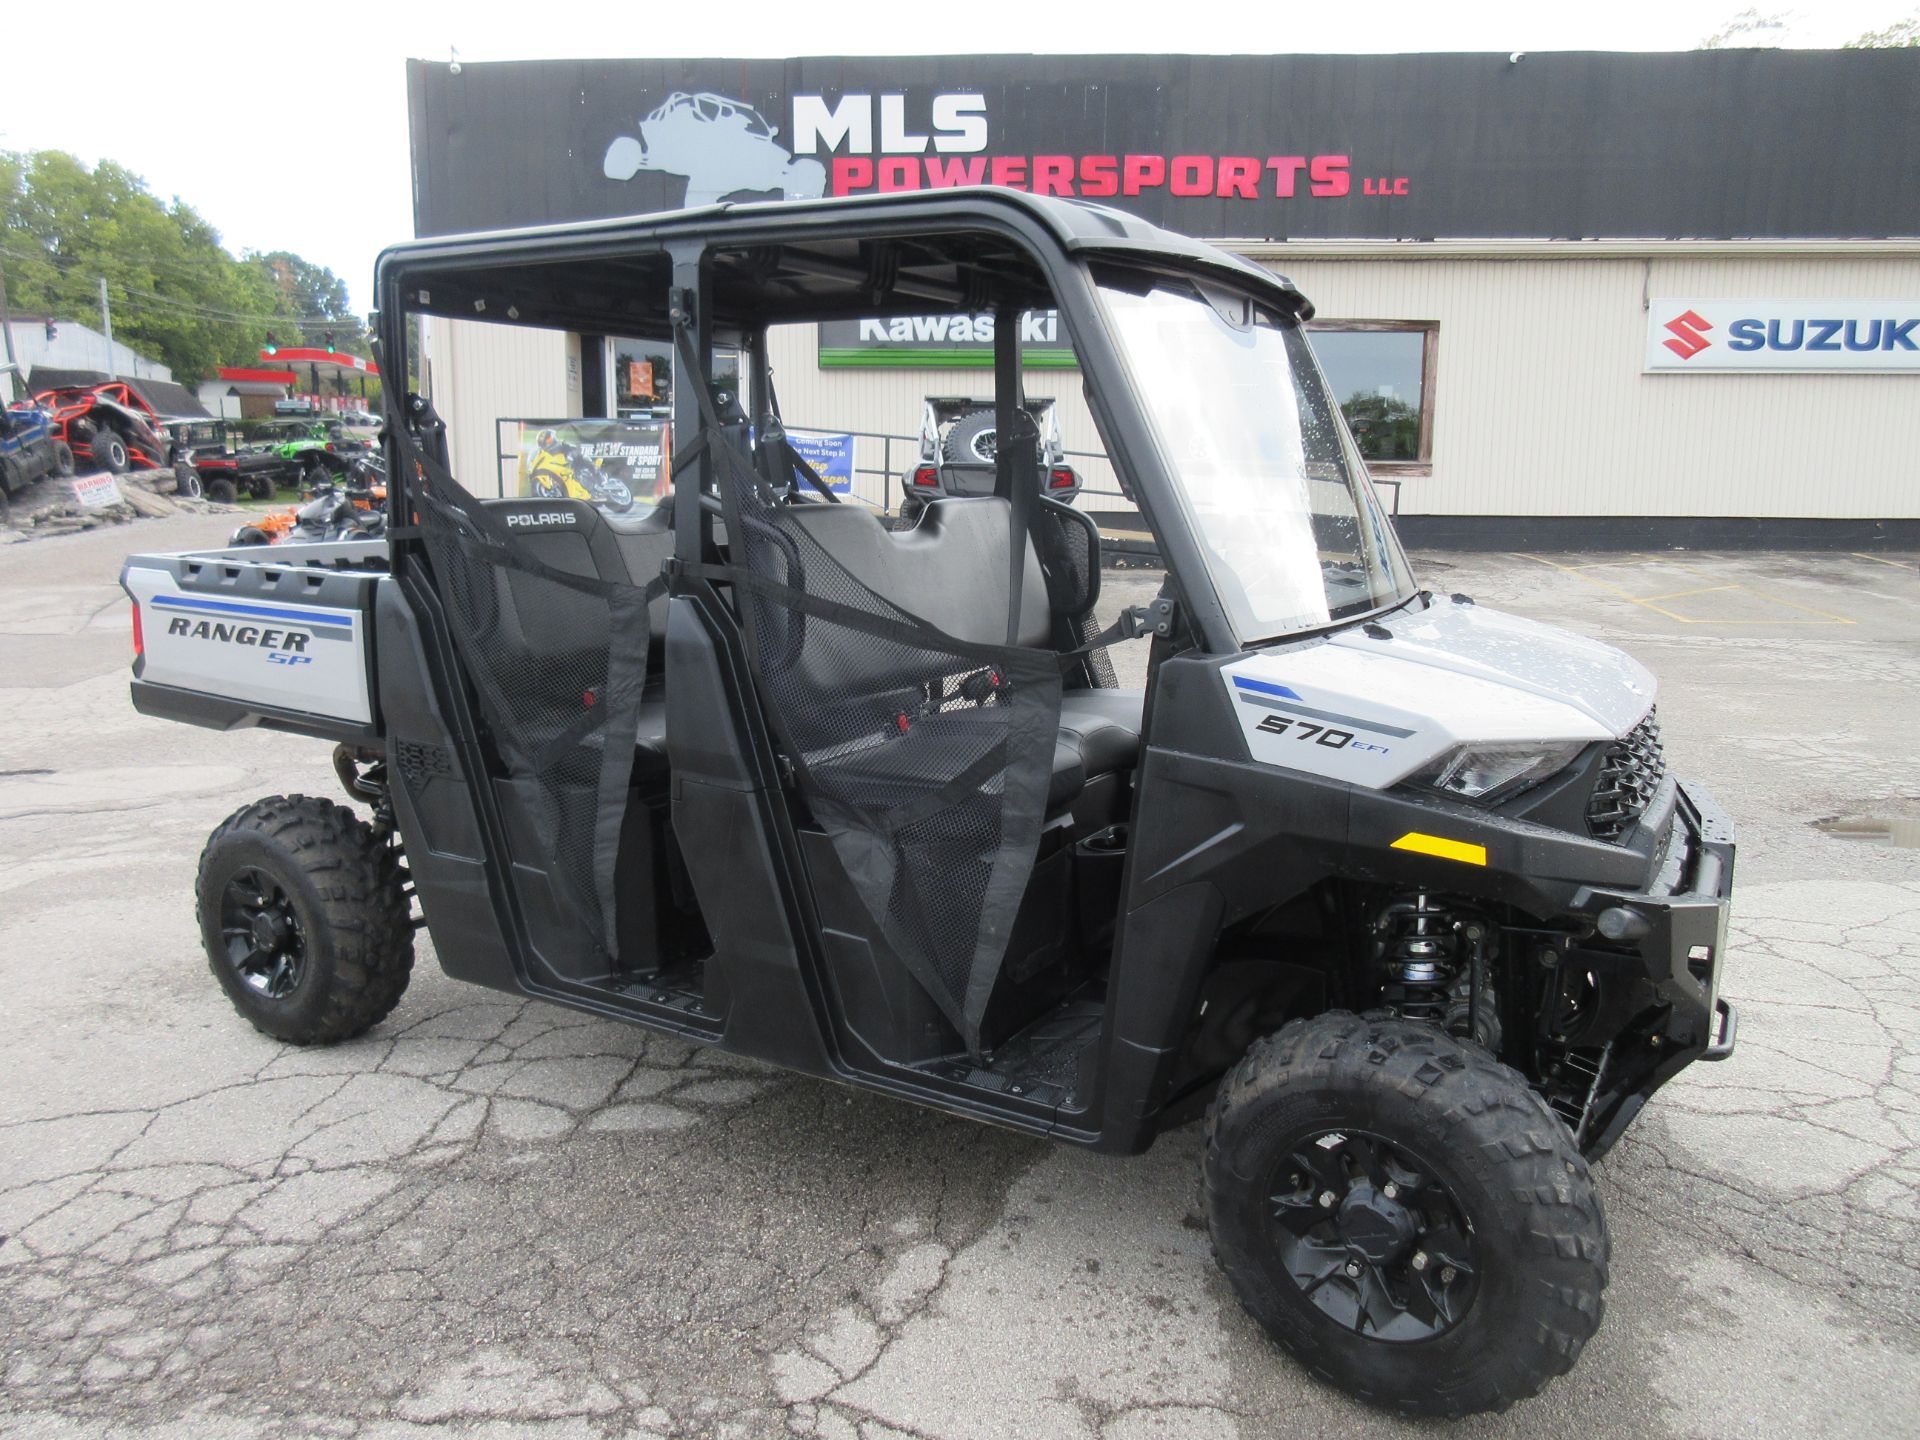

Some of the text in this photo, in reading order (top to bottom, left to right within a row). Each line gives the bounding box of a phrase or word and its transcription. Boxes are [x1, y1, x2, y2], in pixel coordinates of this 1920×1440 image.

[793, 94, 988, 154] MLS
[832, 154, 1409, 199] POWERSPORTS LLC
[859, 310, 1058, 342] Kawaski
[1728, 319, 1920, 351] SUZUK
[581, 442, 660, 456] THE NEW STANDARD
[796, 439, 843, 447] Coming Soon
[627, 455, 662, 466] OF SPORT
[821, 448, 837, 458] Step
[76, 476, 112, 490] WARNING
[506, 512, 577, 527] POLARIS
[168, 617, 310, 652] RANGER
[266, 652, 312, 666] SP
[1255, 714, 1390, 754] 570 EFI
